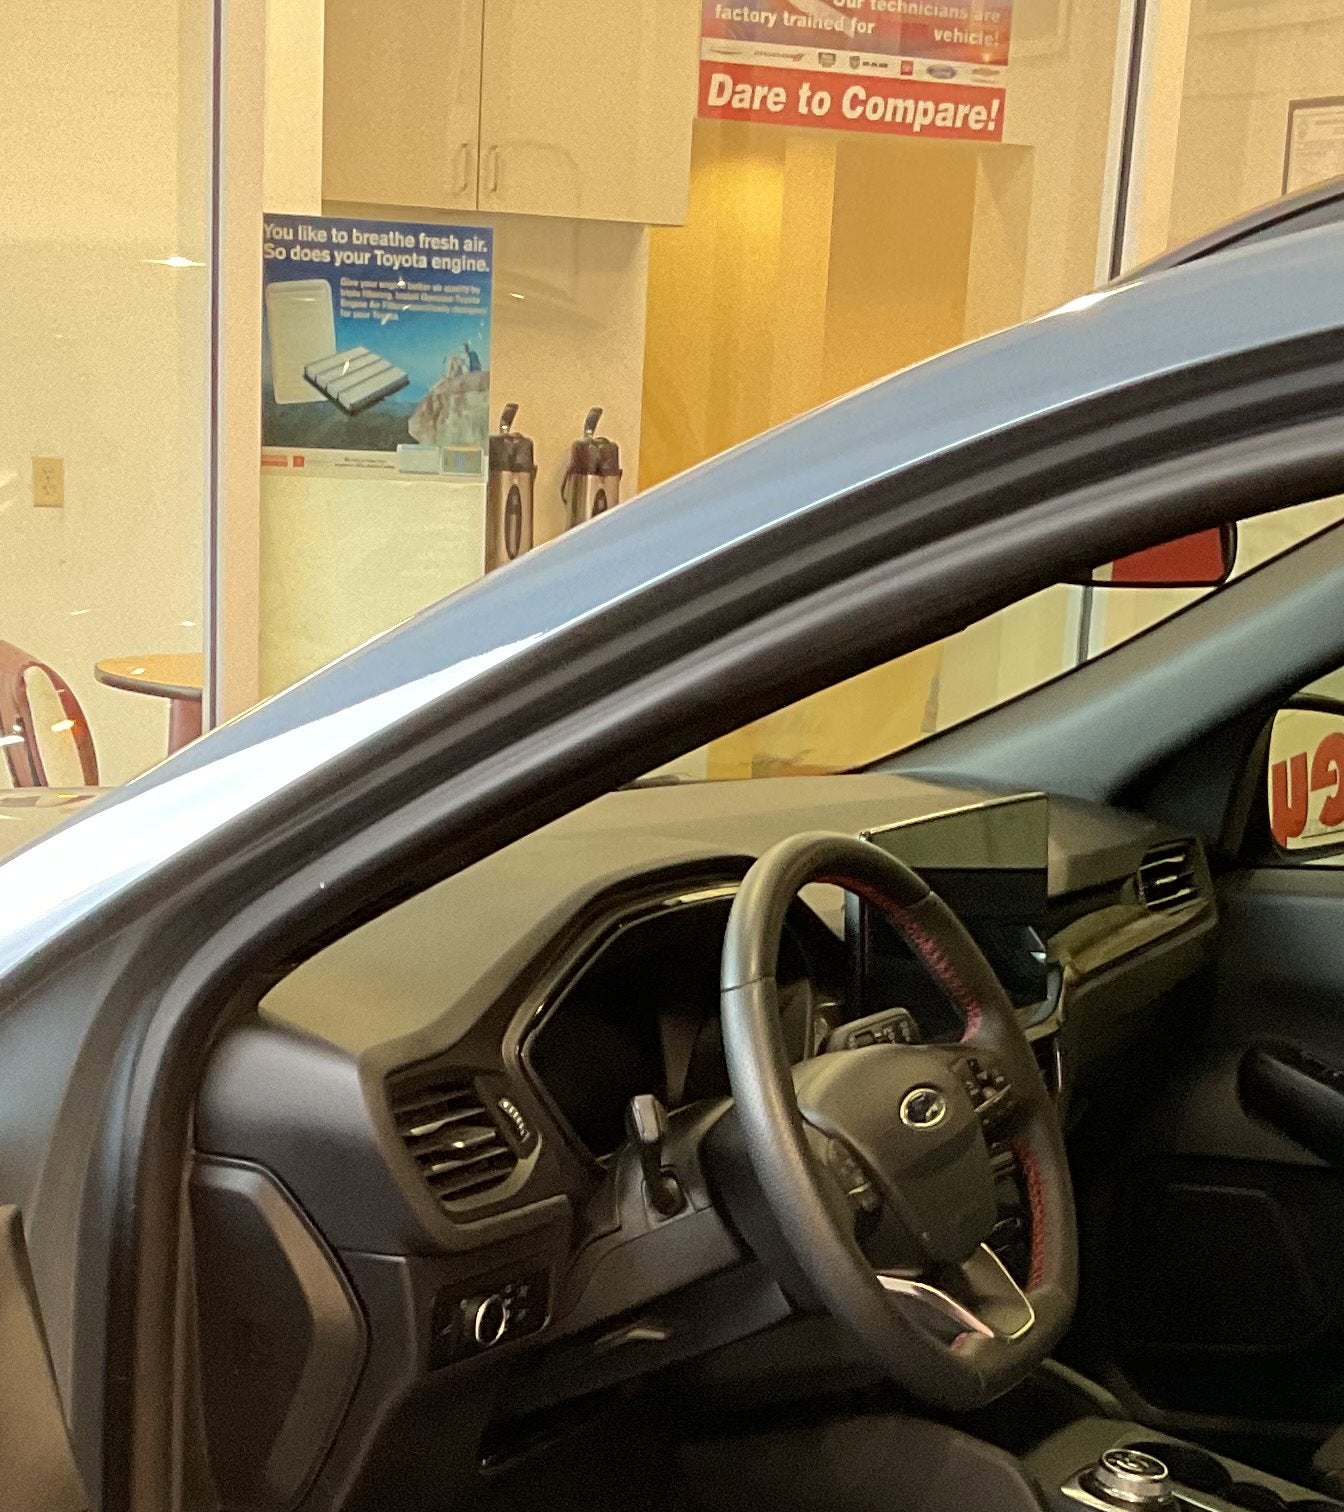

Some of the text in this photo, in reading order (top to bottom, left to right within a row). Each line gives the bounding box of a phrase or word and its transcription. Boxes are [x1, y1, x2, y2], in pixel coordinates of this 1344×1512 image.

[715, 4, 999, 46] factory trained for vehicle!
[871, 0, 968, 20] technicians
[974, 10, 1000, 23] are
[708, 73, 1000, 132] Dare to Compare!
[263, 223, 488, 252] You like to breathe fresh air.
[264, 243, 490, 274] So does your Toyota engine.
